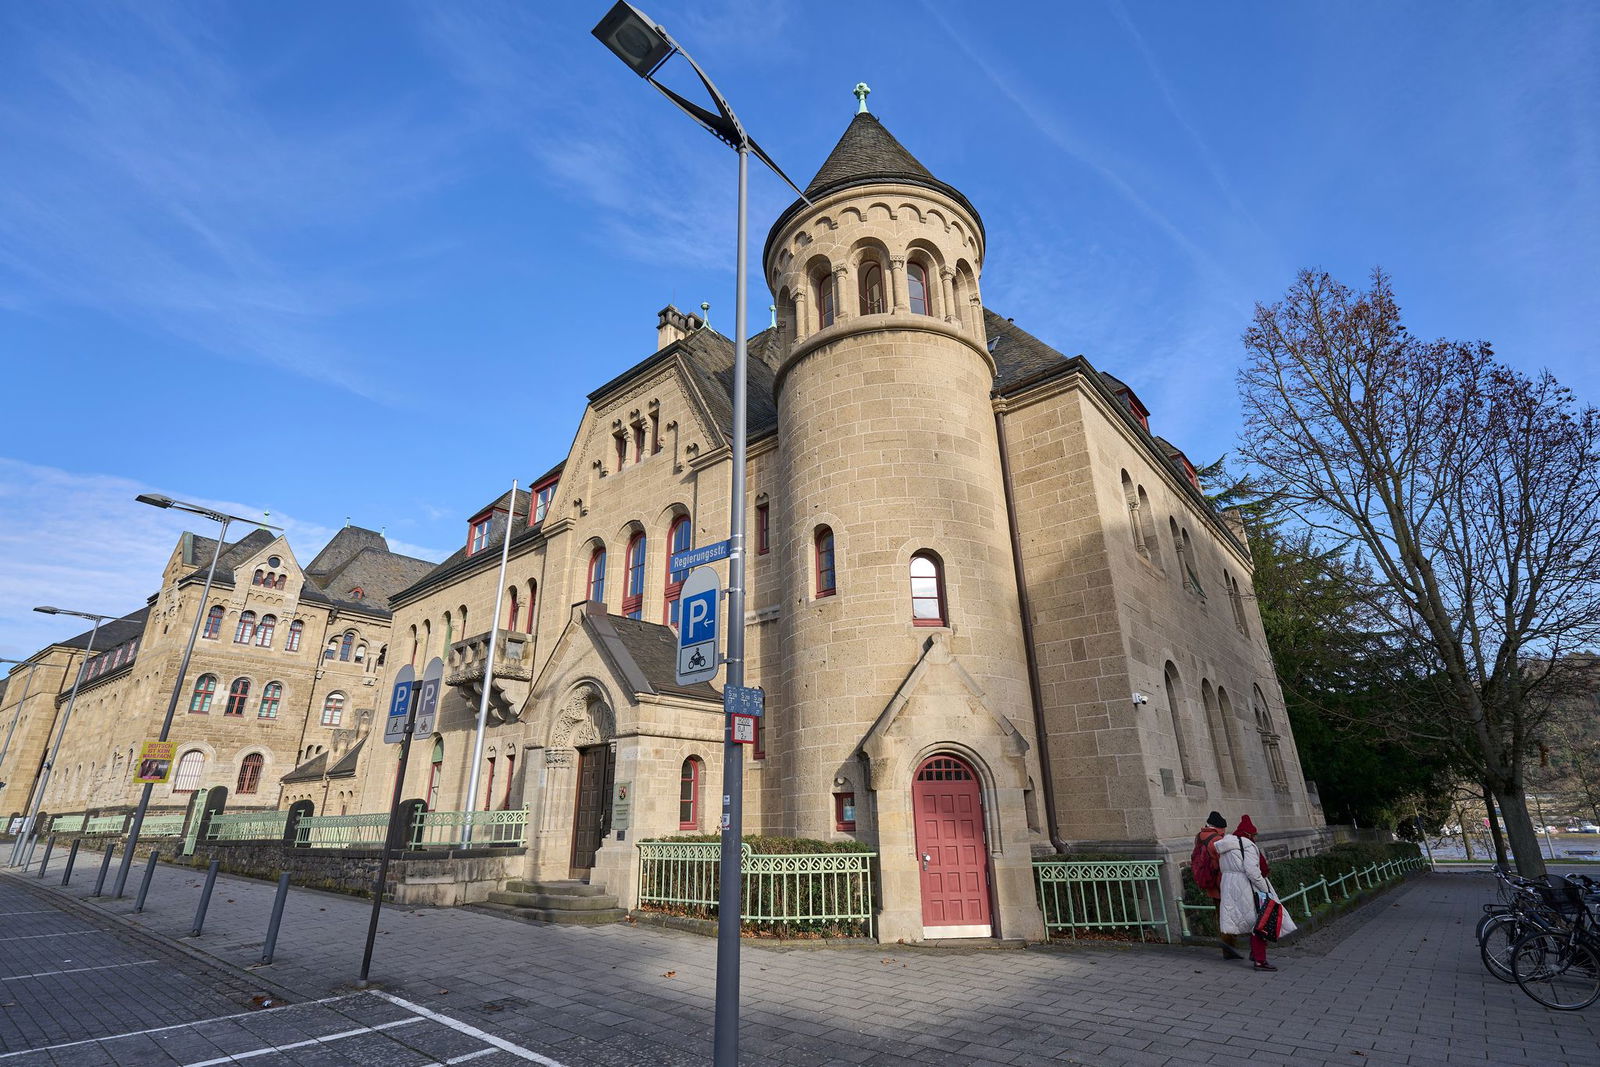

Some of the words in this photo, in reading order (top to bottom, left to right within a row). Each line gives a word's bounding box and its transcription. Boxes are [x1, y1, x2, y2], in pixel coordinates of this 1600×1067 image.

[674, 545, 726, 568] Regierungsstr.
[688, 598, 708, 639] P
[394, 686, 407, 712] P
[422, 684, 435, 711] P
